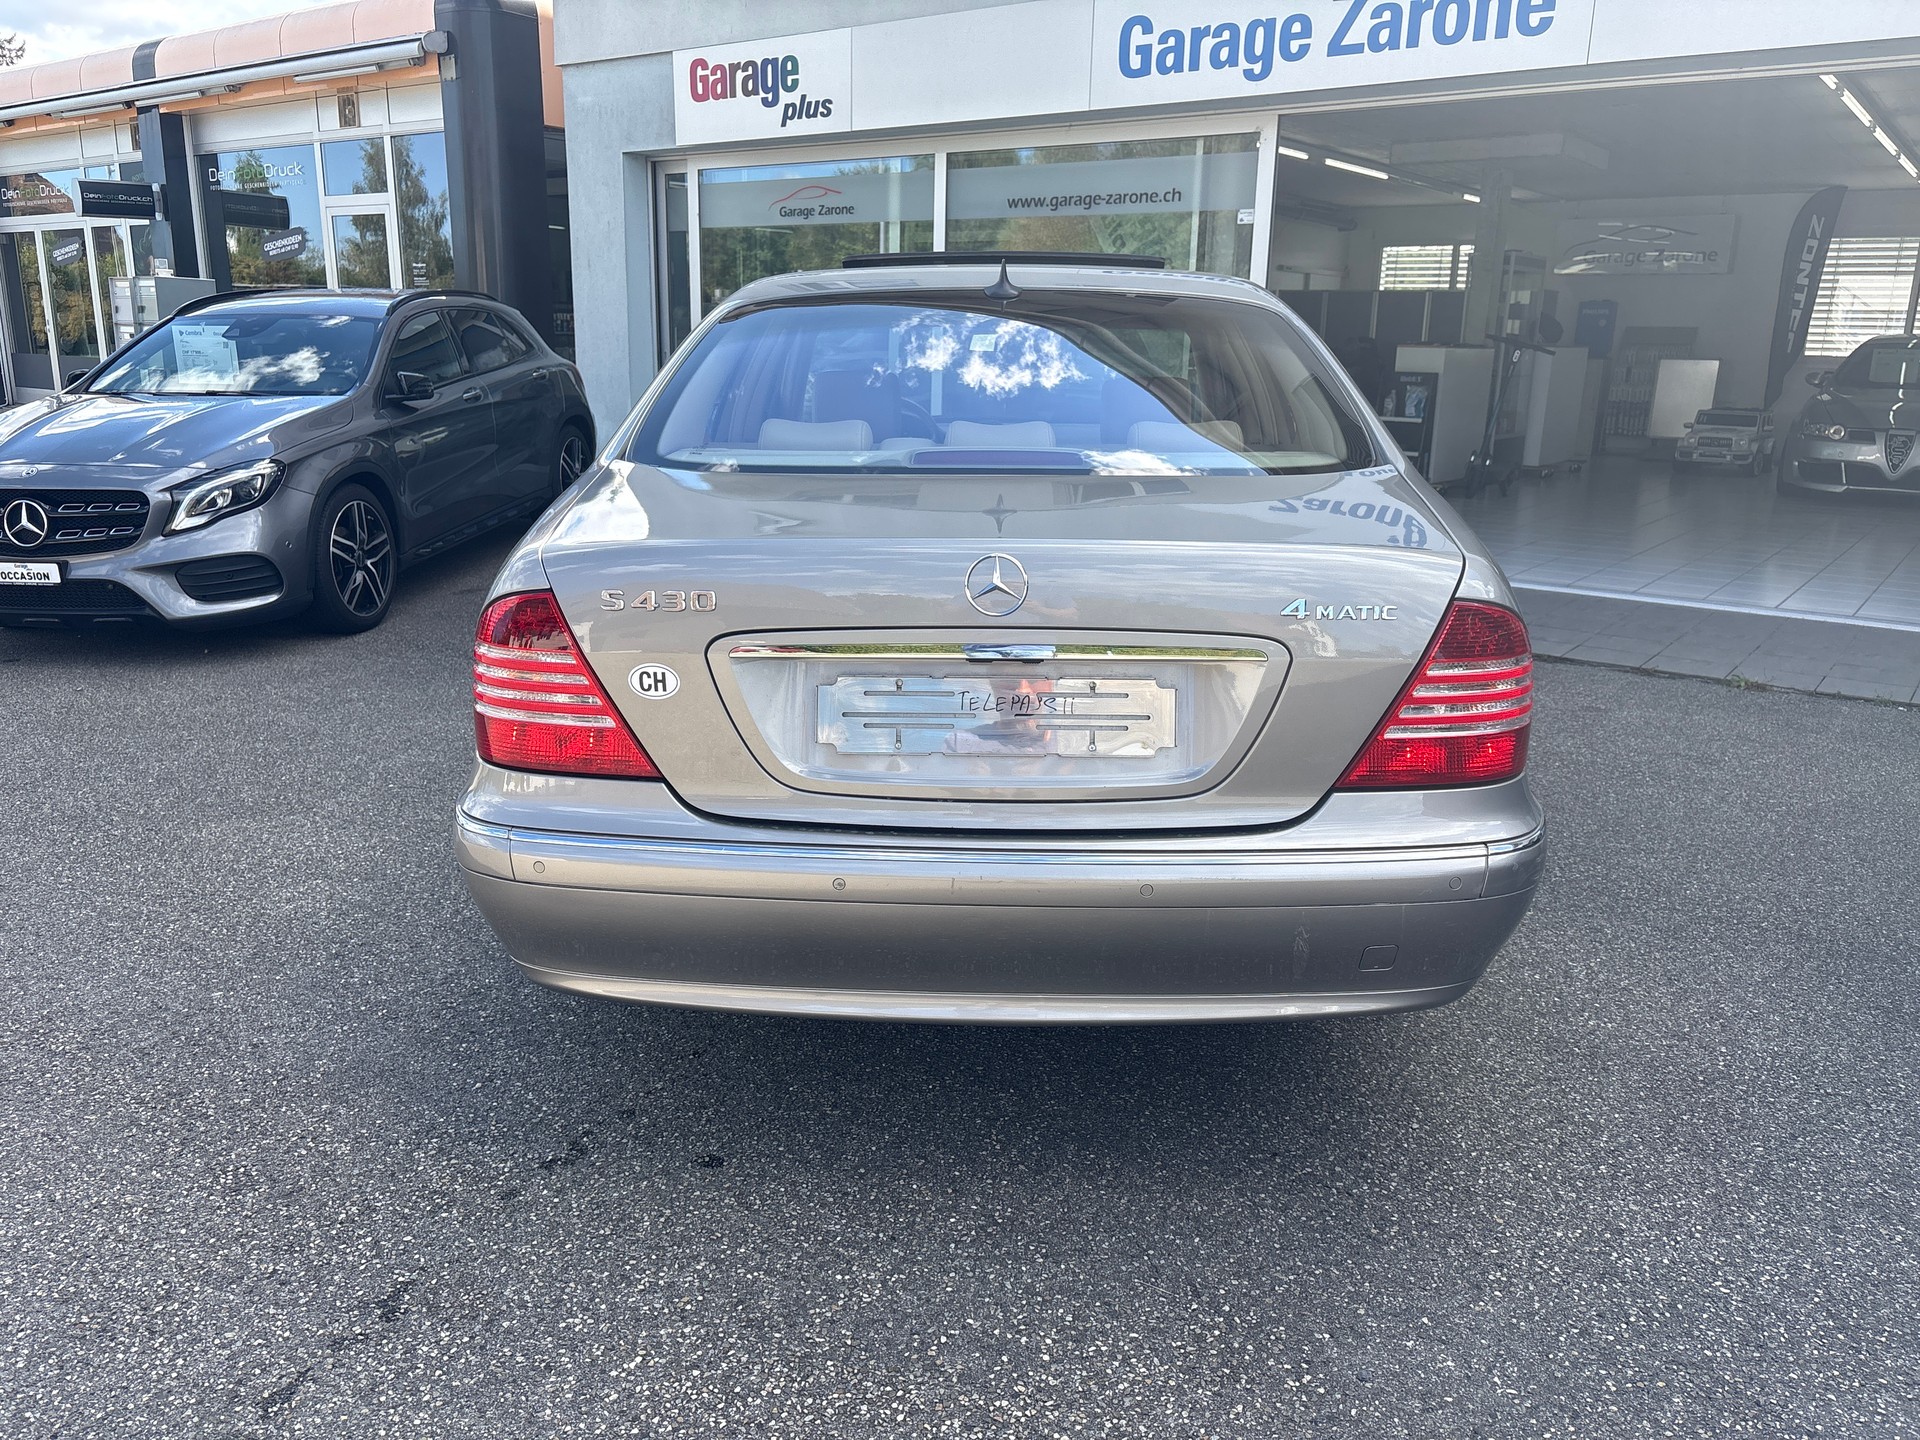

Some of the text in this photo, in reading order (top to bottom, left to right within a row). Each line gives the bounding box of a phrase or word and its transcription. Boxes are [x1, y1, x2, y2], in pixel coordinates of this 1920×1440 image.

[1118, 0, 1557, 82] Garage Zarone
[690, 54, 799, 108] Garage
[780, 94, 833, 127] plus
[207, 161, 303, 182] DeinFotoDruck
[1007, 188, 1182, 211] www.garage-zarone.ch
[779, 204, 855, 220] Garage Zarone
[1584, 249, 1719, 267] Garage Zarone
[0, 571, 51, 581] OCCASION
[639, 671, 667, 692] CH
